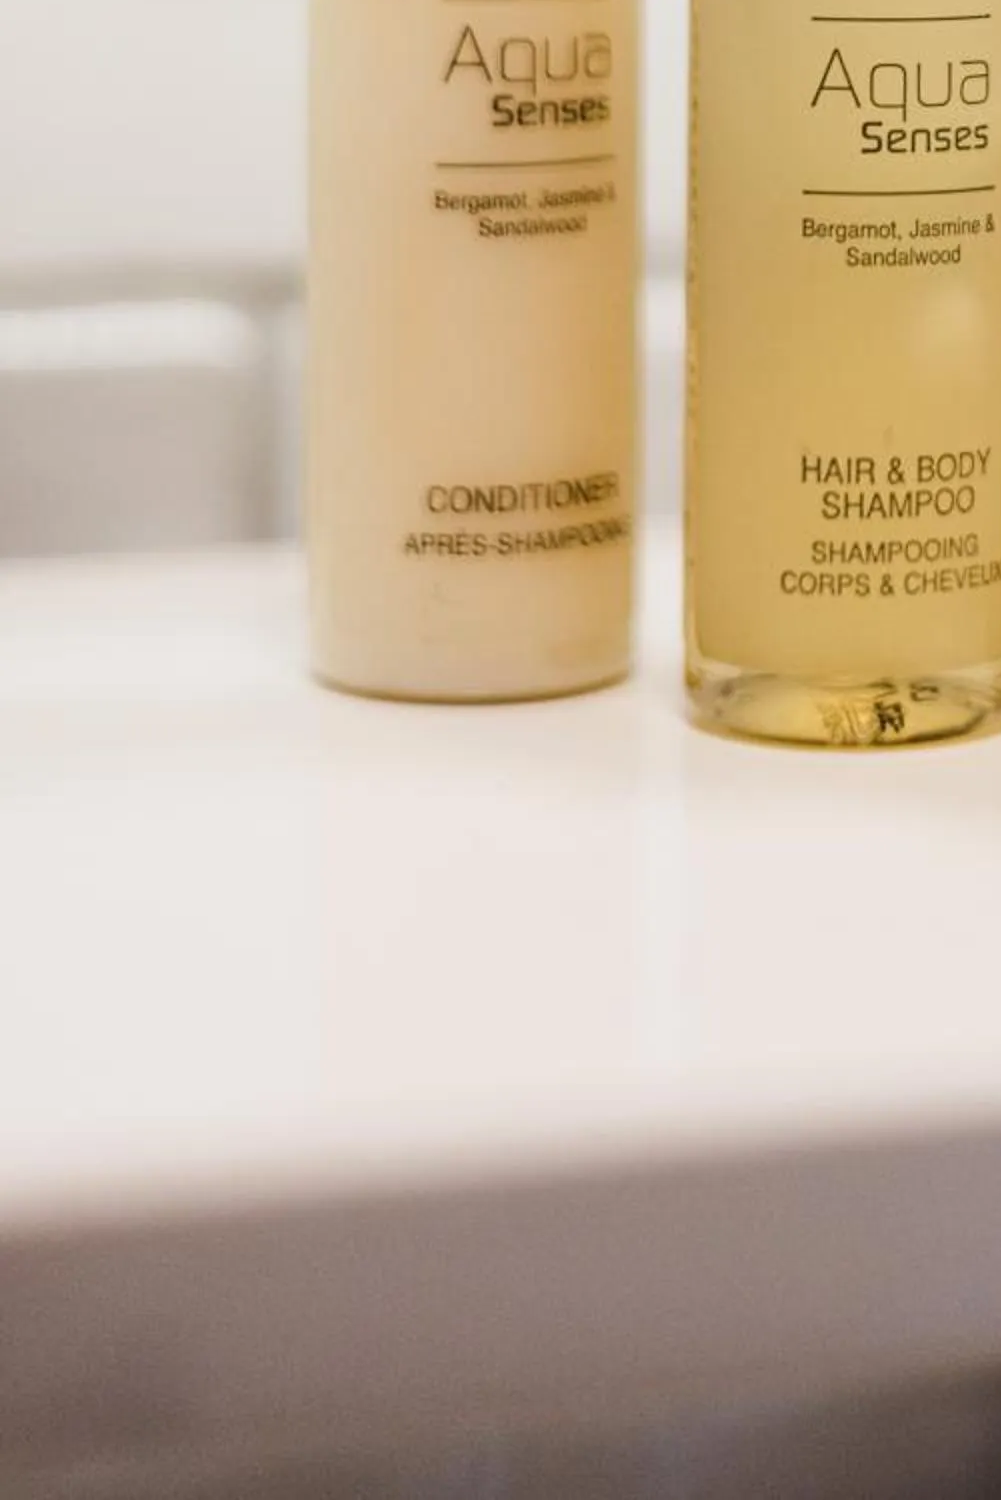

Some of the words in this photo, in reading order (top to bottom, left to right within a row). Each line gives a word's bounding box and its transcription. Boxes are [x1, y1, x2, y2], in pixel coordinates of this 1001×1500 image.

[443, 23, 612, 97] Aqua
[810, 47, 990, 123] Aqua
[491, 93, 611, 128] Senses
[860, 120, 990, 155] Senses
[477, 212, 588, 239] Sandalwood
[801, 217, 903, 245] Bergamot,
[908, 215, 982, 239] Jasmine
[984, 213, 996, 234] &
[846, 243, 962, 269] Sandalwood
[800, 454, 876, 486] HAIR
[886, 455, 906, 486] &
[916, 446, 992, 484] BODY
[820, 484, 977, 521] SHAMPOO
[810, 531, 981, 567] SHAMPOOING
[779, 569, 872, 598] CORPS
[879, 573, 896, 598] &
